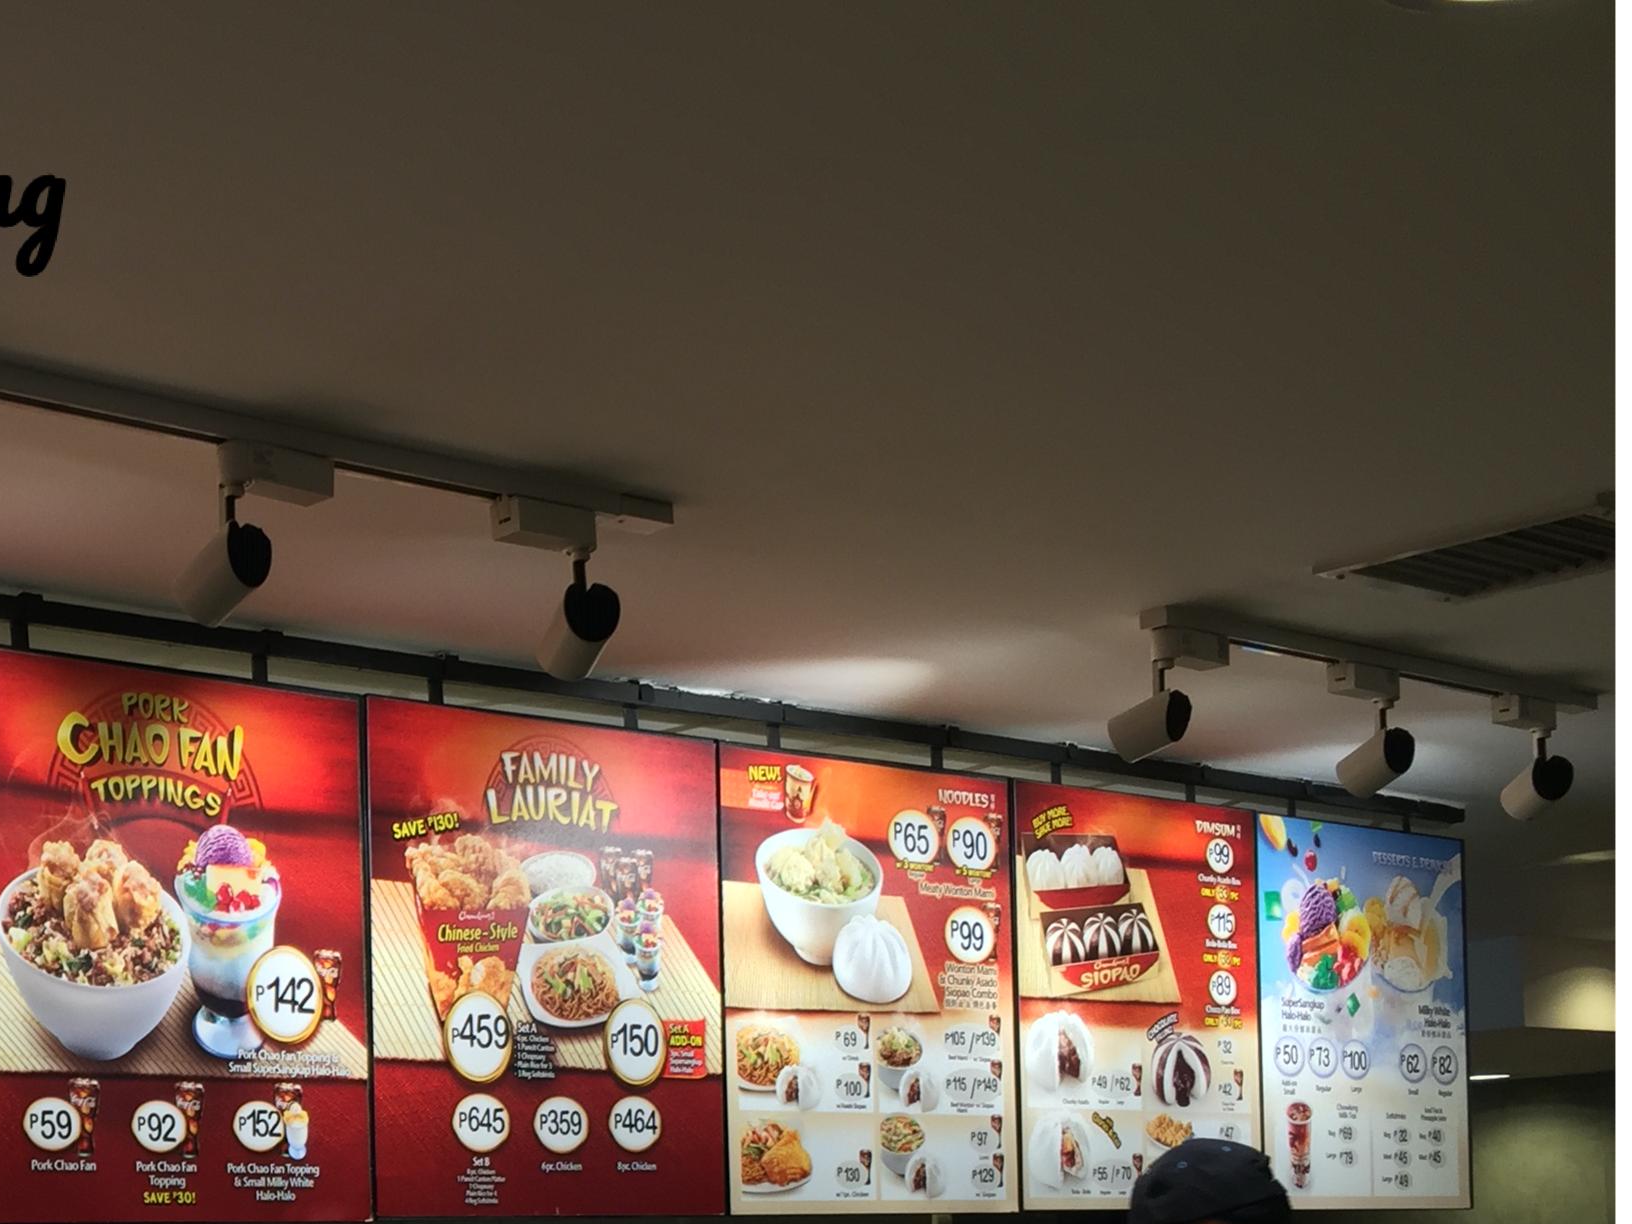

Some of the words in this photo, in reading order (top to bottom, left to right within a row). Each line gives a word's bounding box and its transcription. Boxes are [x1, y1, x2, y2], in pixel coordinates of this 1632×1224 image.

[121, 691, 189, 724] PORK
[56, 711, 169, 766] CHAO
[178, 723, 245, 780] FAN
[501, 750, 601, 792] FAMILY
[748, 765, 782, 782] NEW!
[90, 775, 222, 817] TOPPINGS
[937, 788, 989, 808] NOODLES
[486, 785, 619, 834] LAURIAT
[392, 817, 426, 840] SAVE
[1195, 819, 1236, 838] DIMSUM
[1080, 963, 1141, 989] SIOPAO
[238, 1049, 258, 1062] Pork
[259, 1050, 281, 1062] Chao
[281, 1050, 295, 1063] Fan
[296, 1051, 329, 1066] Topping
[228, 1062, 253, 1074] Small
[31, 1160, 55, 1172] Pork
[56, 1160, 79, 1172] Chao
[80, 1161, 97, 1172] Fan
[136, 1161, 157, 1173] Pork
[158, 1162, 180, 1173] Chao
[181, 1163, 197, 1173] Fan
[227, 1163, 248, 1175] Pork
[248, 1163, 269, 1175] Chao
[270, 1164, 285, 1175] Fan
[285, 1164, 320, 1178] Topping
[555, 1161, 583, 1172] Chicken
[631, 1161, 657, 1172] Chicken
[149, 1175, 186, 1189] Topping
[243, 1176, 266, 1188] Small
[266, 1177, 288, 1190] Milky
[288, 1178, 315, 1189] White
[143, 1192, 170, 1205] SAVE
